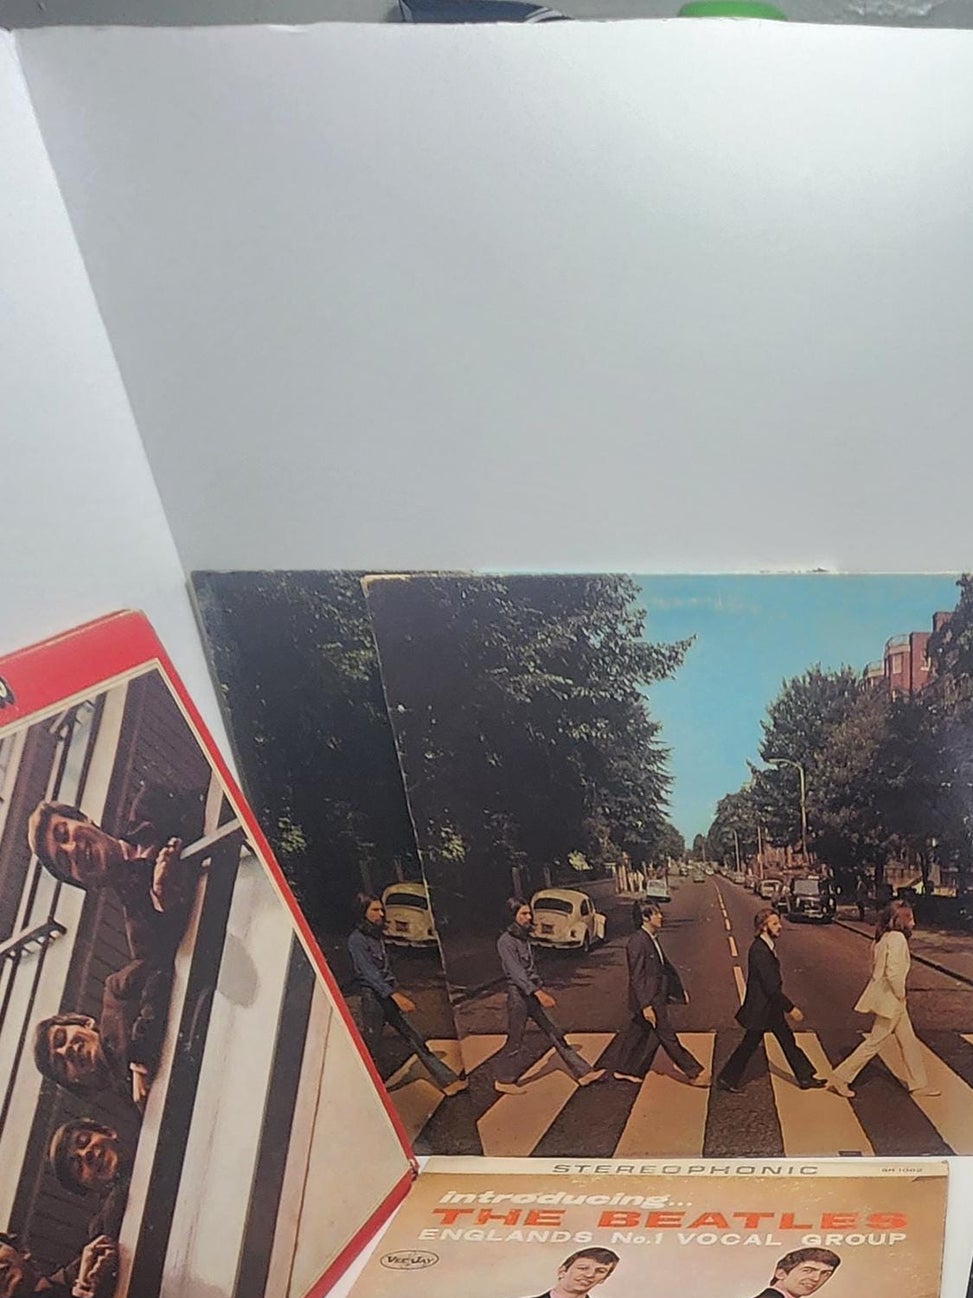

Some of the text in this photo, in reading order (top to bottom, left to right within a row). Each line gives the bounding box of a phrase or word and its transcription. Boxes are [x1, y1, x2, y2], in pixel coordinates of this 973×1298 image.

[552, 1164, 819, 1175] STEREOPHONIC
[432, 1208, 909, 1230] THE BEATLES
[417, 1228, 593, 1244] ENGLANDS
[677, 1232, 783, 1247] VOCAL
[802, 1232, 907, 1247] GROUP
